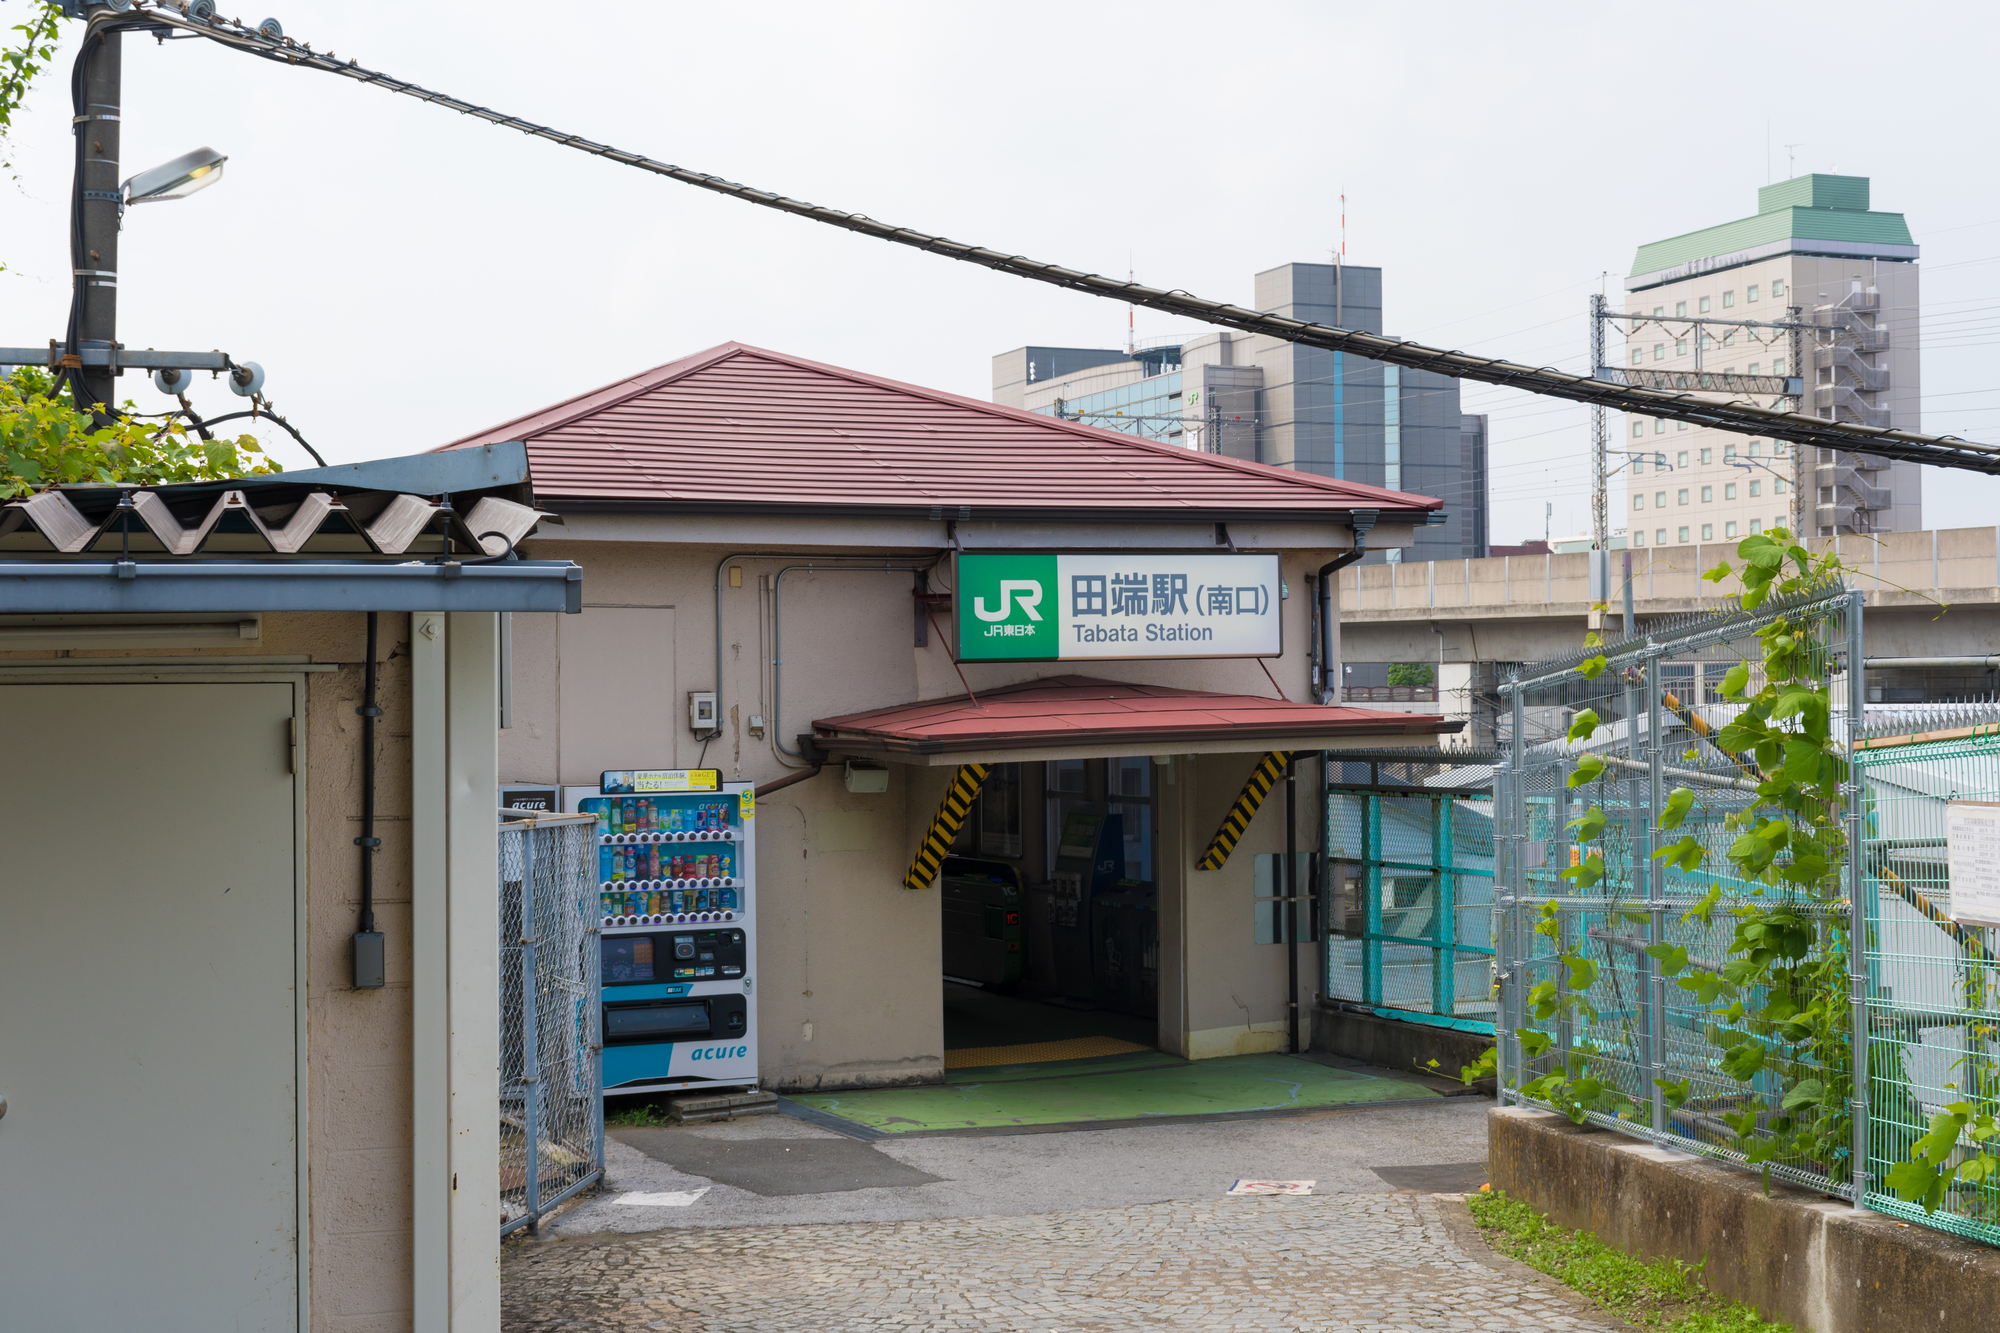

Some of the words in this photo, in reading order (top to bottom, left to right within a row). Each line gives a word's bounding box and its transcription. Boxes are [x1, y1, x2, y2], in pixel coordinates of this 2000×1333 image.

[1683, 255, 1715, 276] METS
[1187, 391, 1199, 405] JR
[974, 579, 1044, 622] JR
[984, 624, 1036, 637] JR東日本
[1072, 624, 1138, 642] Tabata
[1145, 623, 1213, 642] Station
[512, 801, 546, 810] acure
[1097, 860, 1115, 871] JR
[1002, 886, 1017, 896] IC
[1007, 913, 1018, 924] IC
[691, 1045, 748, 1061] acure
